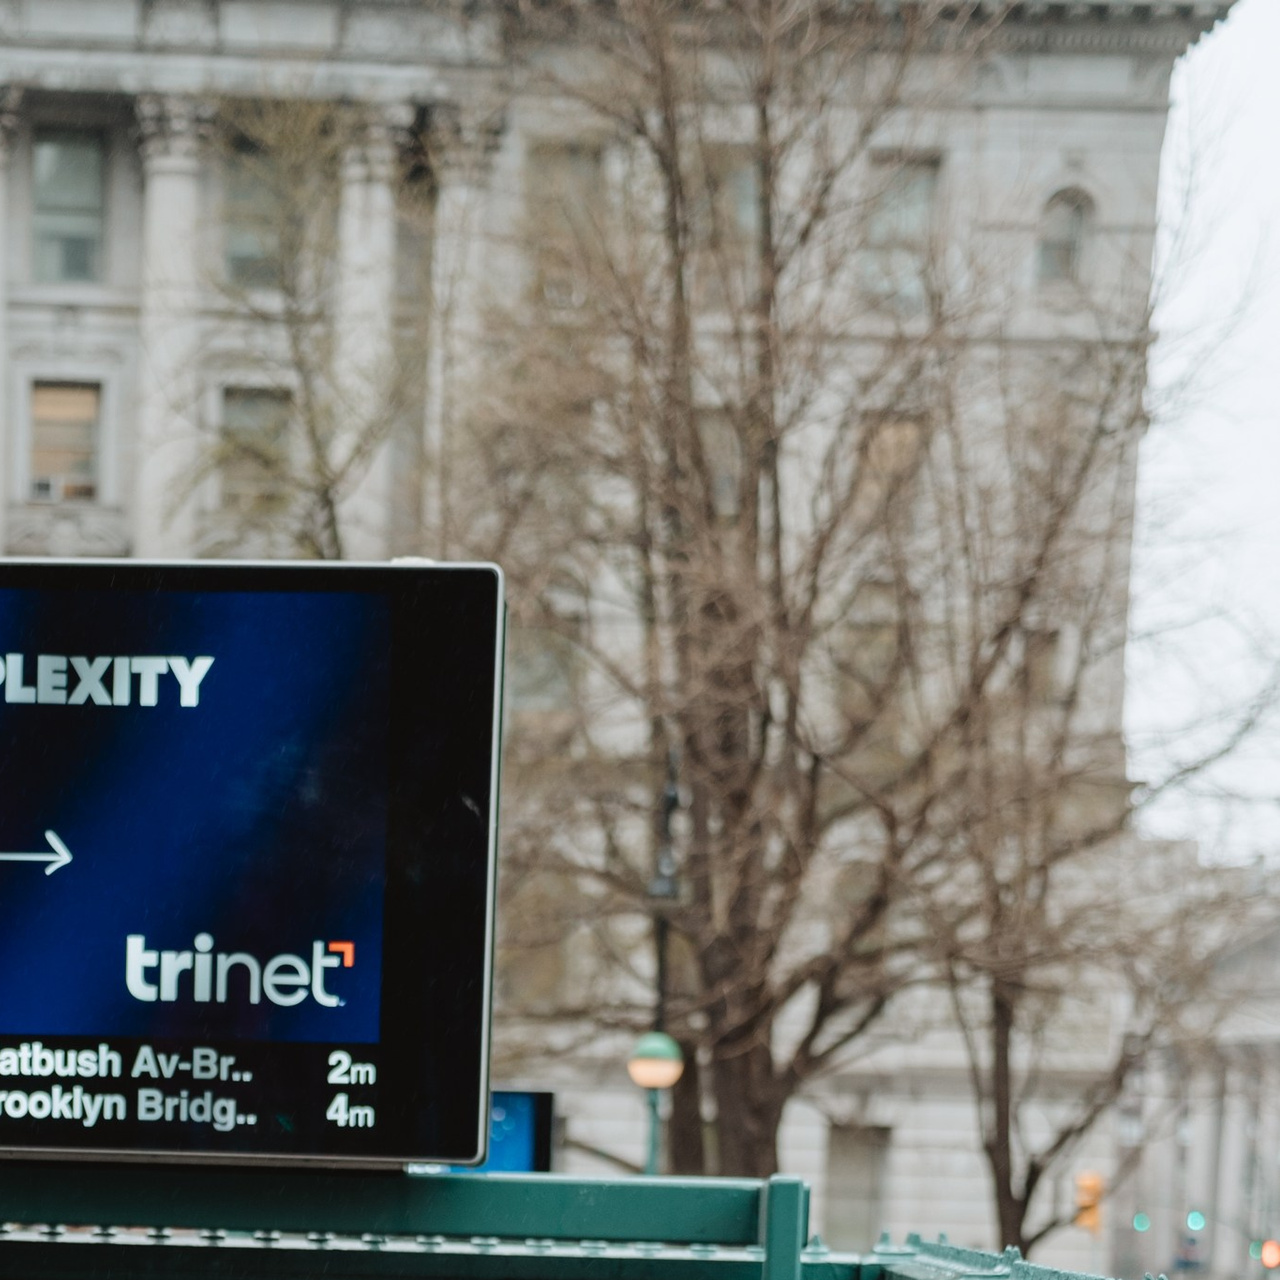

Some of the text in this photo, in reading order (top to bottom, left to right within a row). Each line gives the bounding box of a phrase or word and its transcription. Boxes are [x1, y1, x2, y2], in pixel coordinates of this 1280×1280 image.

[125, 932, 342, 1007] trinet
[130, 1045, 253, 1083] Av-Br..
[327, 1050, 376, 1085] 2m
[137, 1088, 257, 1132] Bridg..
[326, 1093, 375, 1128] 4m
